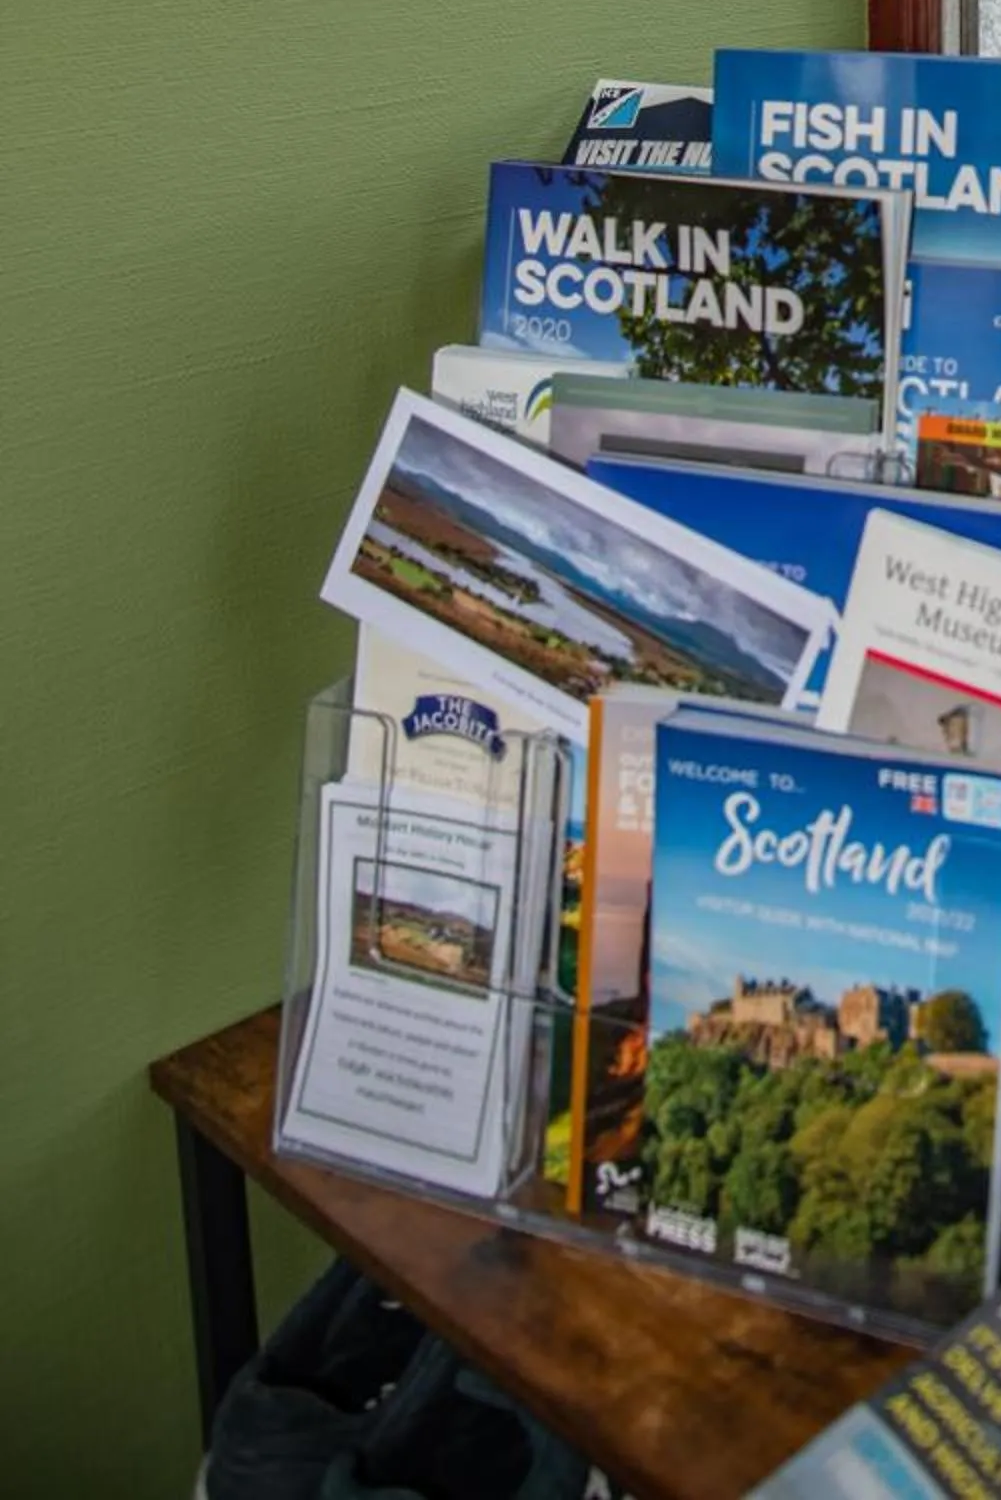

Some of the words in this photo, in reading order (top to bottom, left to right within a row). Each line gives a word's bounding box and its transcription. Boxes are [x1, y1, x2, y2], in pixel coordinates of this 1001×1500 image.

[761, 101, 885, 153] FISH
[901, 109, 957, 158] IN
[576, 139, 640, 166] VISIT
[636, 141, 684, 167] THE
[518, 208, 667, 269] WALK
[677, 225, 730, 275] IN
[513, 260, 804, 335] SCOTLAND
[514, 314, 571, 342] 2020
[934, 356, 957, 376] TO
[884, 554, 950, 599] West
[439, 697, 471, 715] THE
[668, 759, 759, 789] WELCOME
[878, 769, 937, 793] FREE
[715, 792, 950, 900] Scotland
